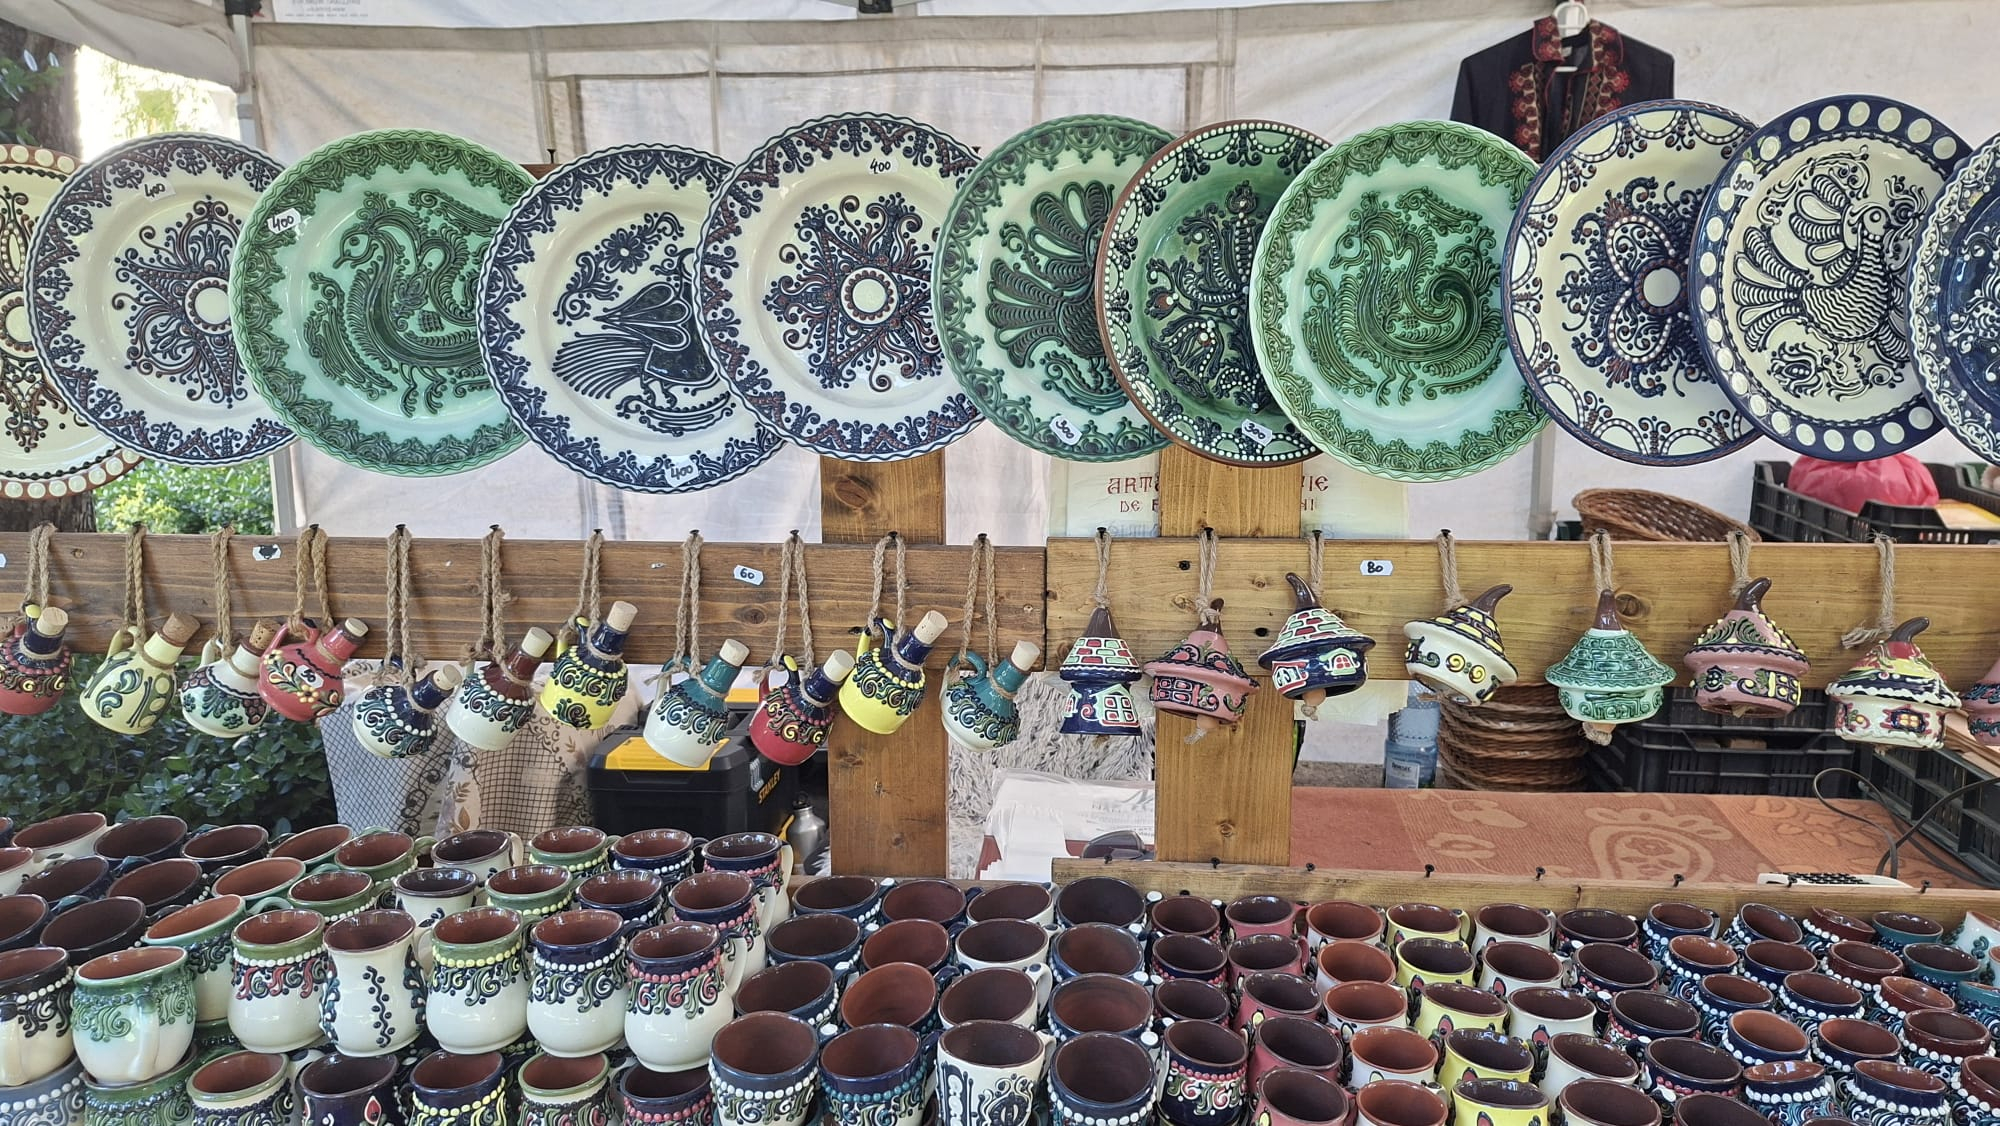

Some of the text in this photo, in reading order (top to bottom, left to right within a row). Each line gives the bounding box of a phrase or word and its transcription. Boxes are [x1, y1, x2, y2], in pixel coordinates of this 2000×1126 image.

[870, 158, 891, 174] 400
[144, 183, 166, 198] 400
[272, 215, 295, 231] 400
[1055, 420, 1075, 439] 300
[1244, 422, 1266, 440] 300
[670, 465, 694, 480] 400
[1120, 499, 1140, 512] DE
[740, 567, 755, 580] 60
[1367, 561, 1384, 573] 80
[758, 767, 781, 805] STANLEY
